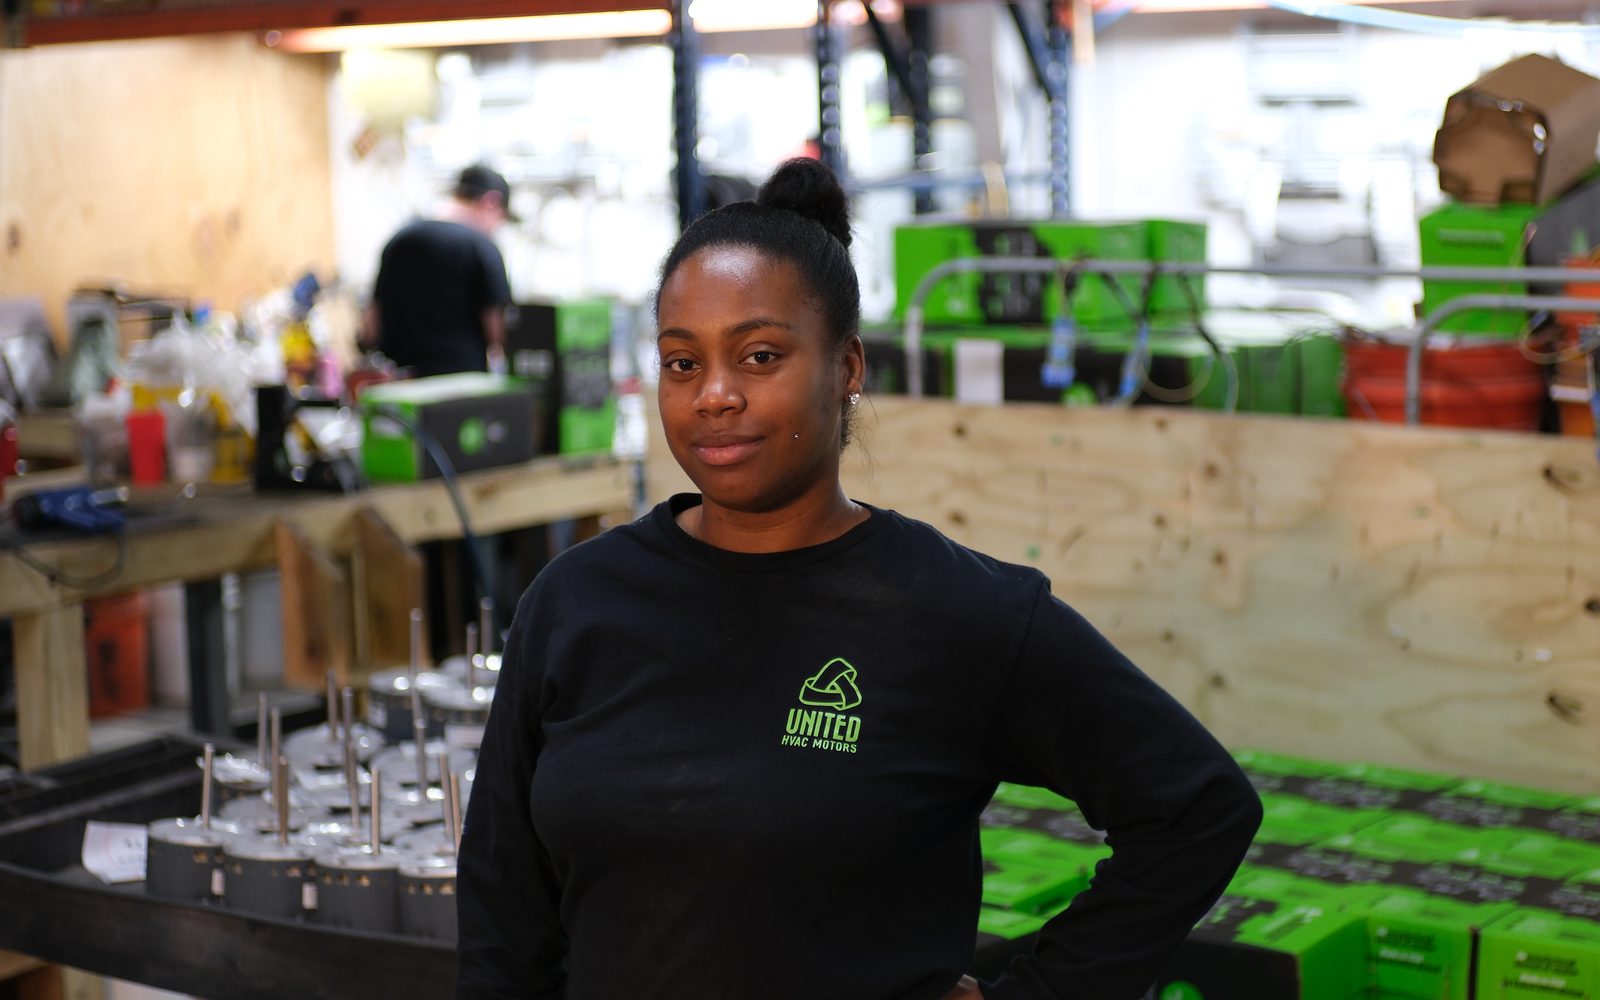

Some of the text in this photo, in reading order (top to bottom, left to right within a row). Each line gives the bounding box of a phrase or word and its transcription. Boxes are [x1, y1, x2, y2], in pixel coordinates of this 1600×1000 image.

[786, 708, 861, 742] UNITED
[781, 734, 857, 753] HVAC MOTORS
